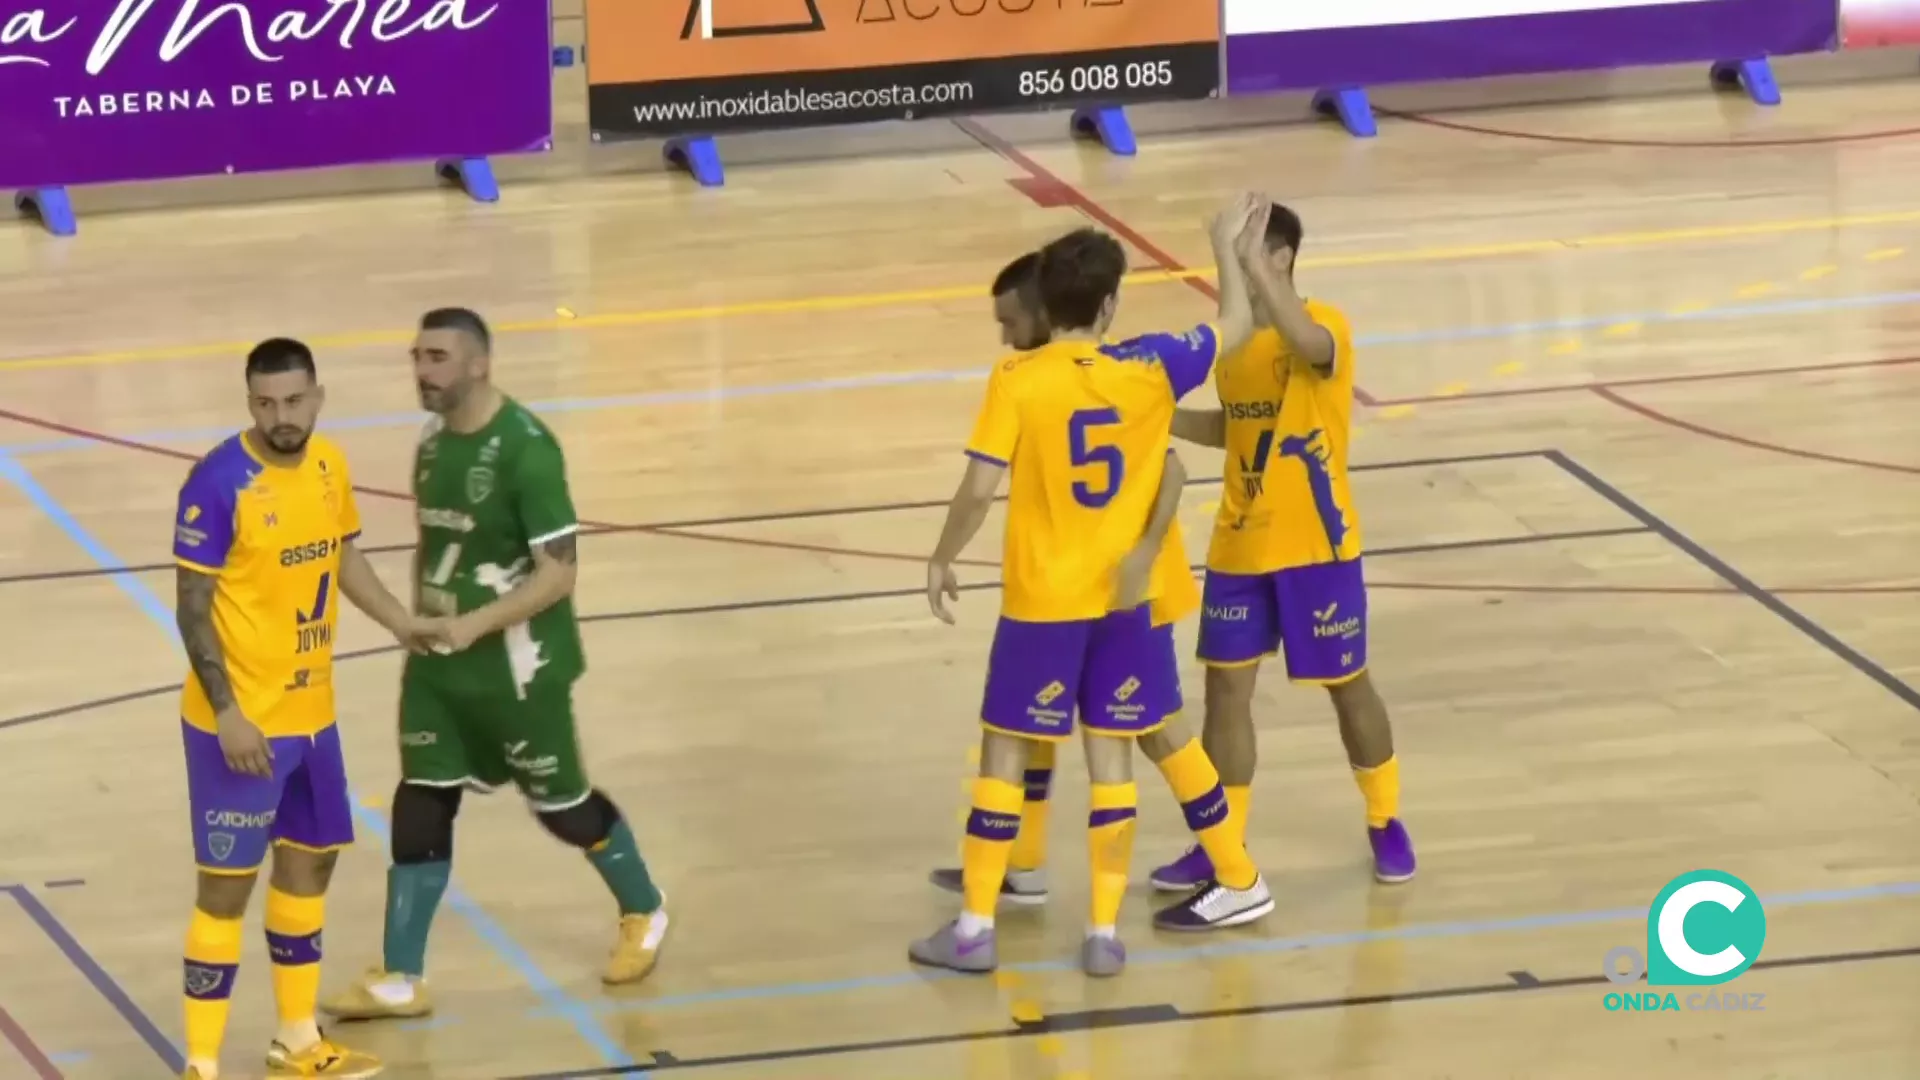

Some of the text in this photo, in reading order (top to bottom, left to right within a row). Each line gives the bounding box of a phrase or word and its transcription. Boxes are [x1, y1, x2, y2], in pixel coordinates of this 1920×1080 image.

[54, 74, 398, 119] TABERNA DE PLAYA
[633, 78, 974, 125] www.inoxidablesacosta.com
[1018, 60, 1173, 97] 856 008 085
[1067, 407, 1126, 509] 5
